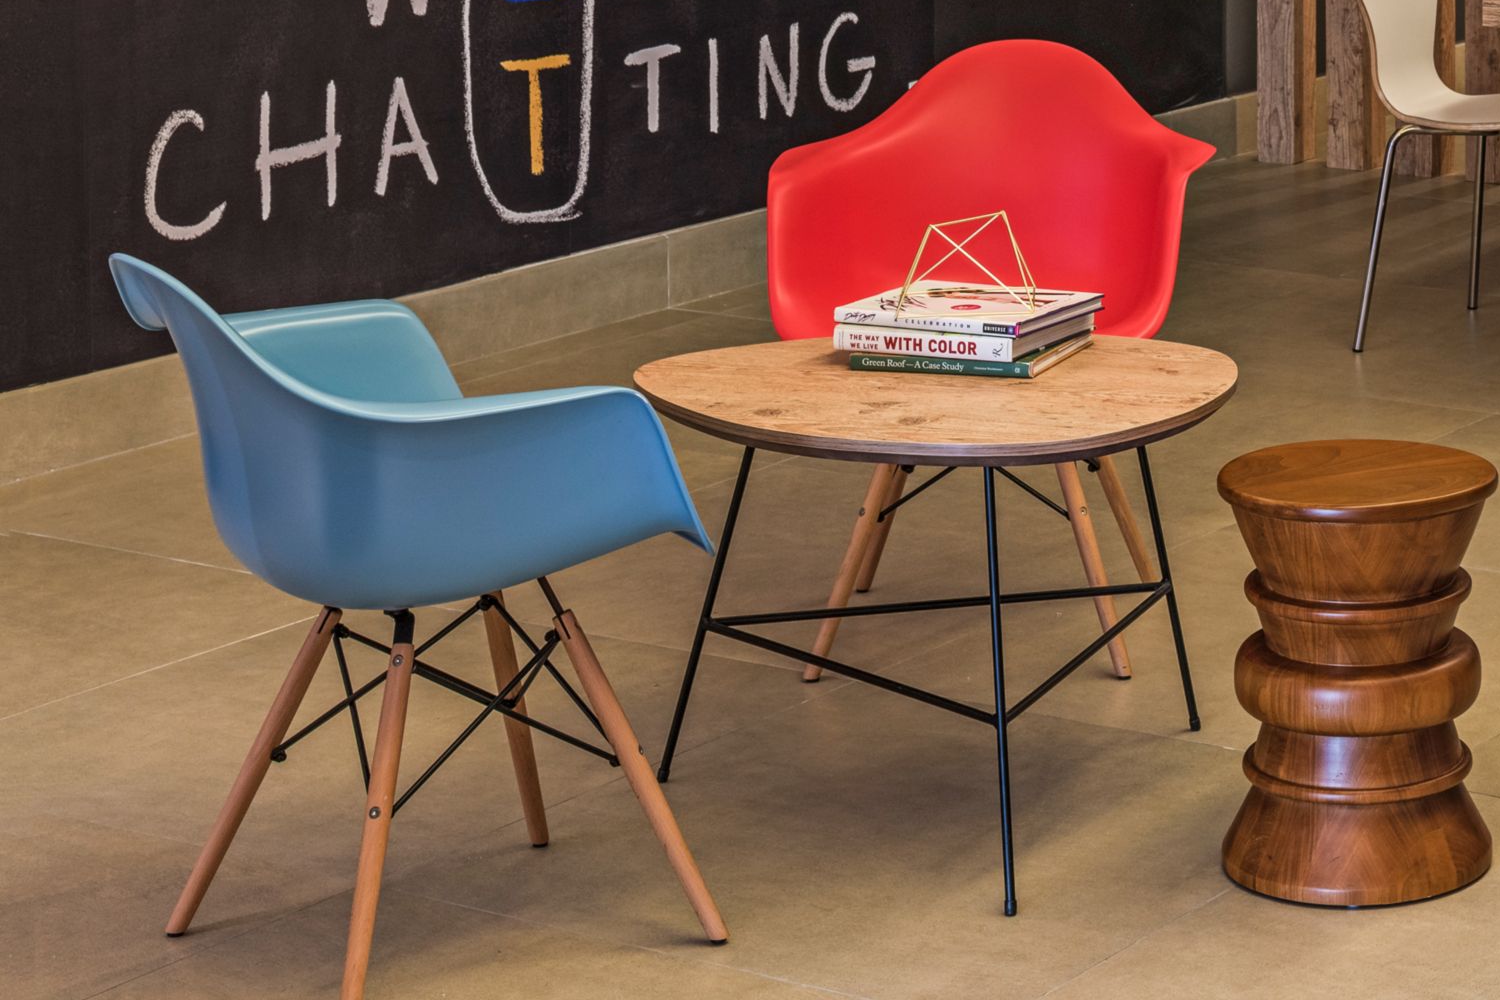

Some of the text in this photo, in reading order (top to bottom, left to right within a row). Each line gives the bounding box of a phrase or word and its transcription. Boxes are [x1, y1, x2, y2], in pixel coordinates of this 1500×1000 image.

[904, 318, 972, 329] CELEBRATION
[983, 325, 1007, 333] UNIVERSE
[849, 333, 880, 342] THE WAY
[883, 335, 978, 356] WITH COLOR
[861, 357, 886, 367] Green
[887, 358, 906, 368] Roof
[921, 360, 941, 370] Case
[941, 361, 965, 372] Study
